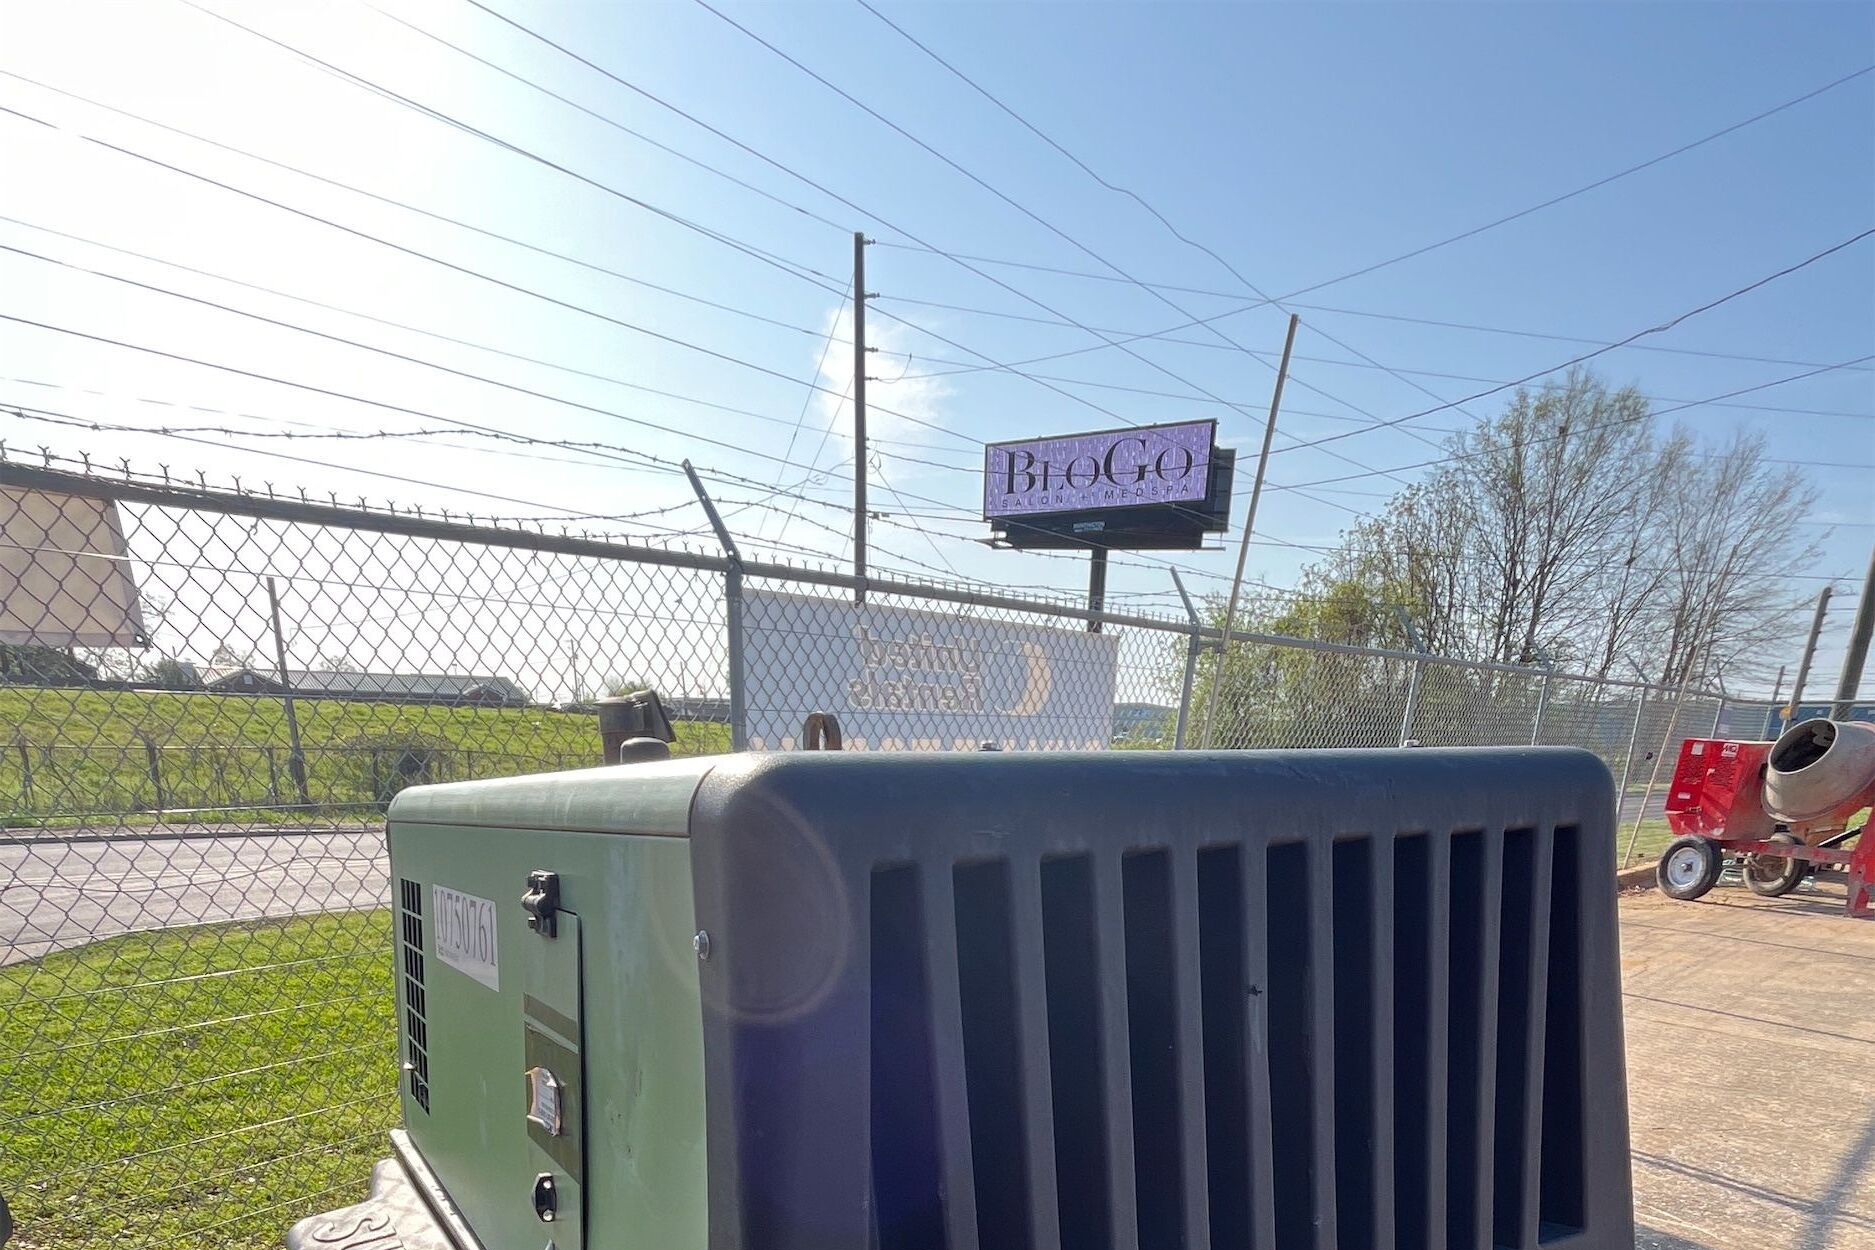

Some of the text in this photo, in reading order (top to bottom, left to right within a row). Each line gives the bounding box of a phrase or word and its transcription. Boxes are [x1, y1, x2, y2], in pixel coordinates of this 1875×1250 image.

[1002, 494, 1063, 509] SALON
[1105, 483, 1190, 500] MEDSPA
[435, 887, 496, 967] 10750761
